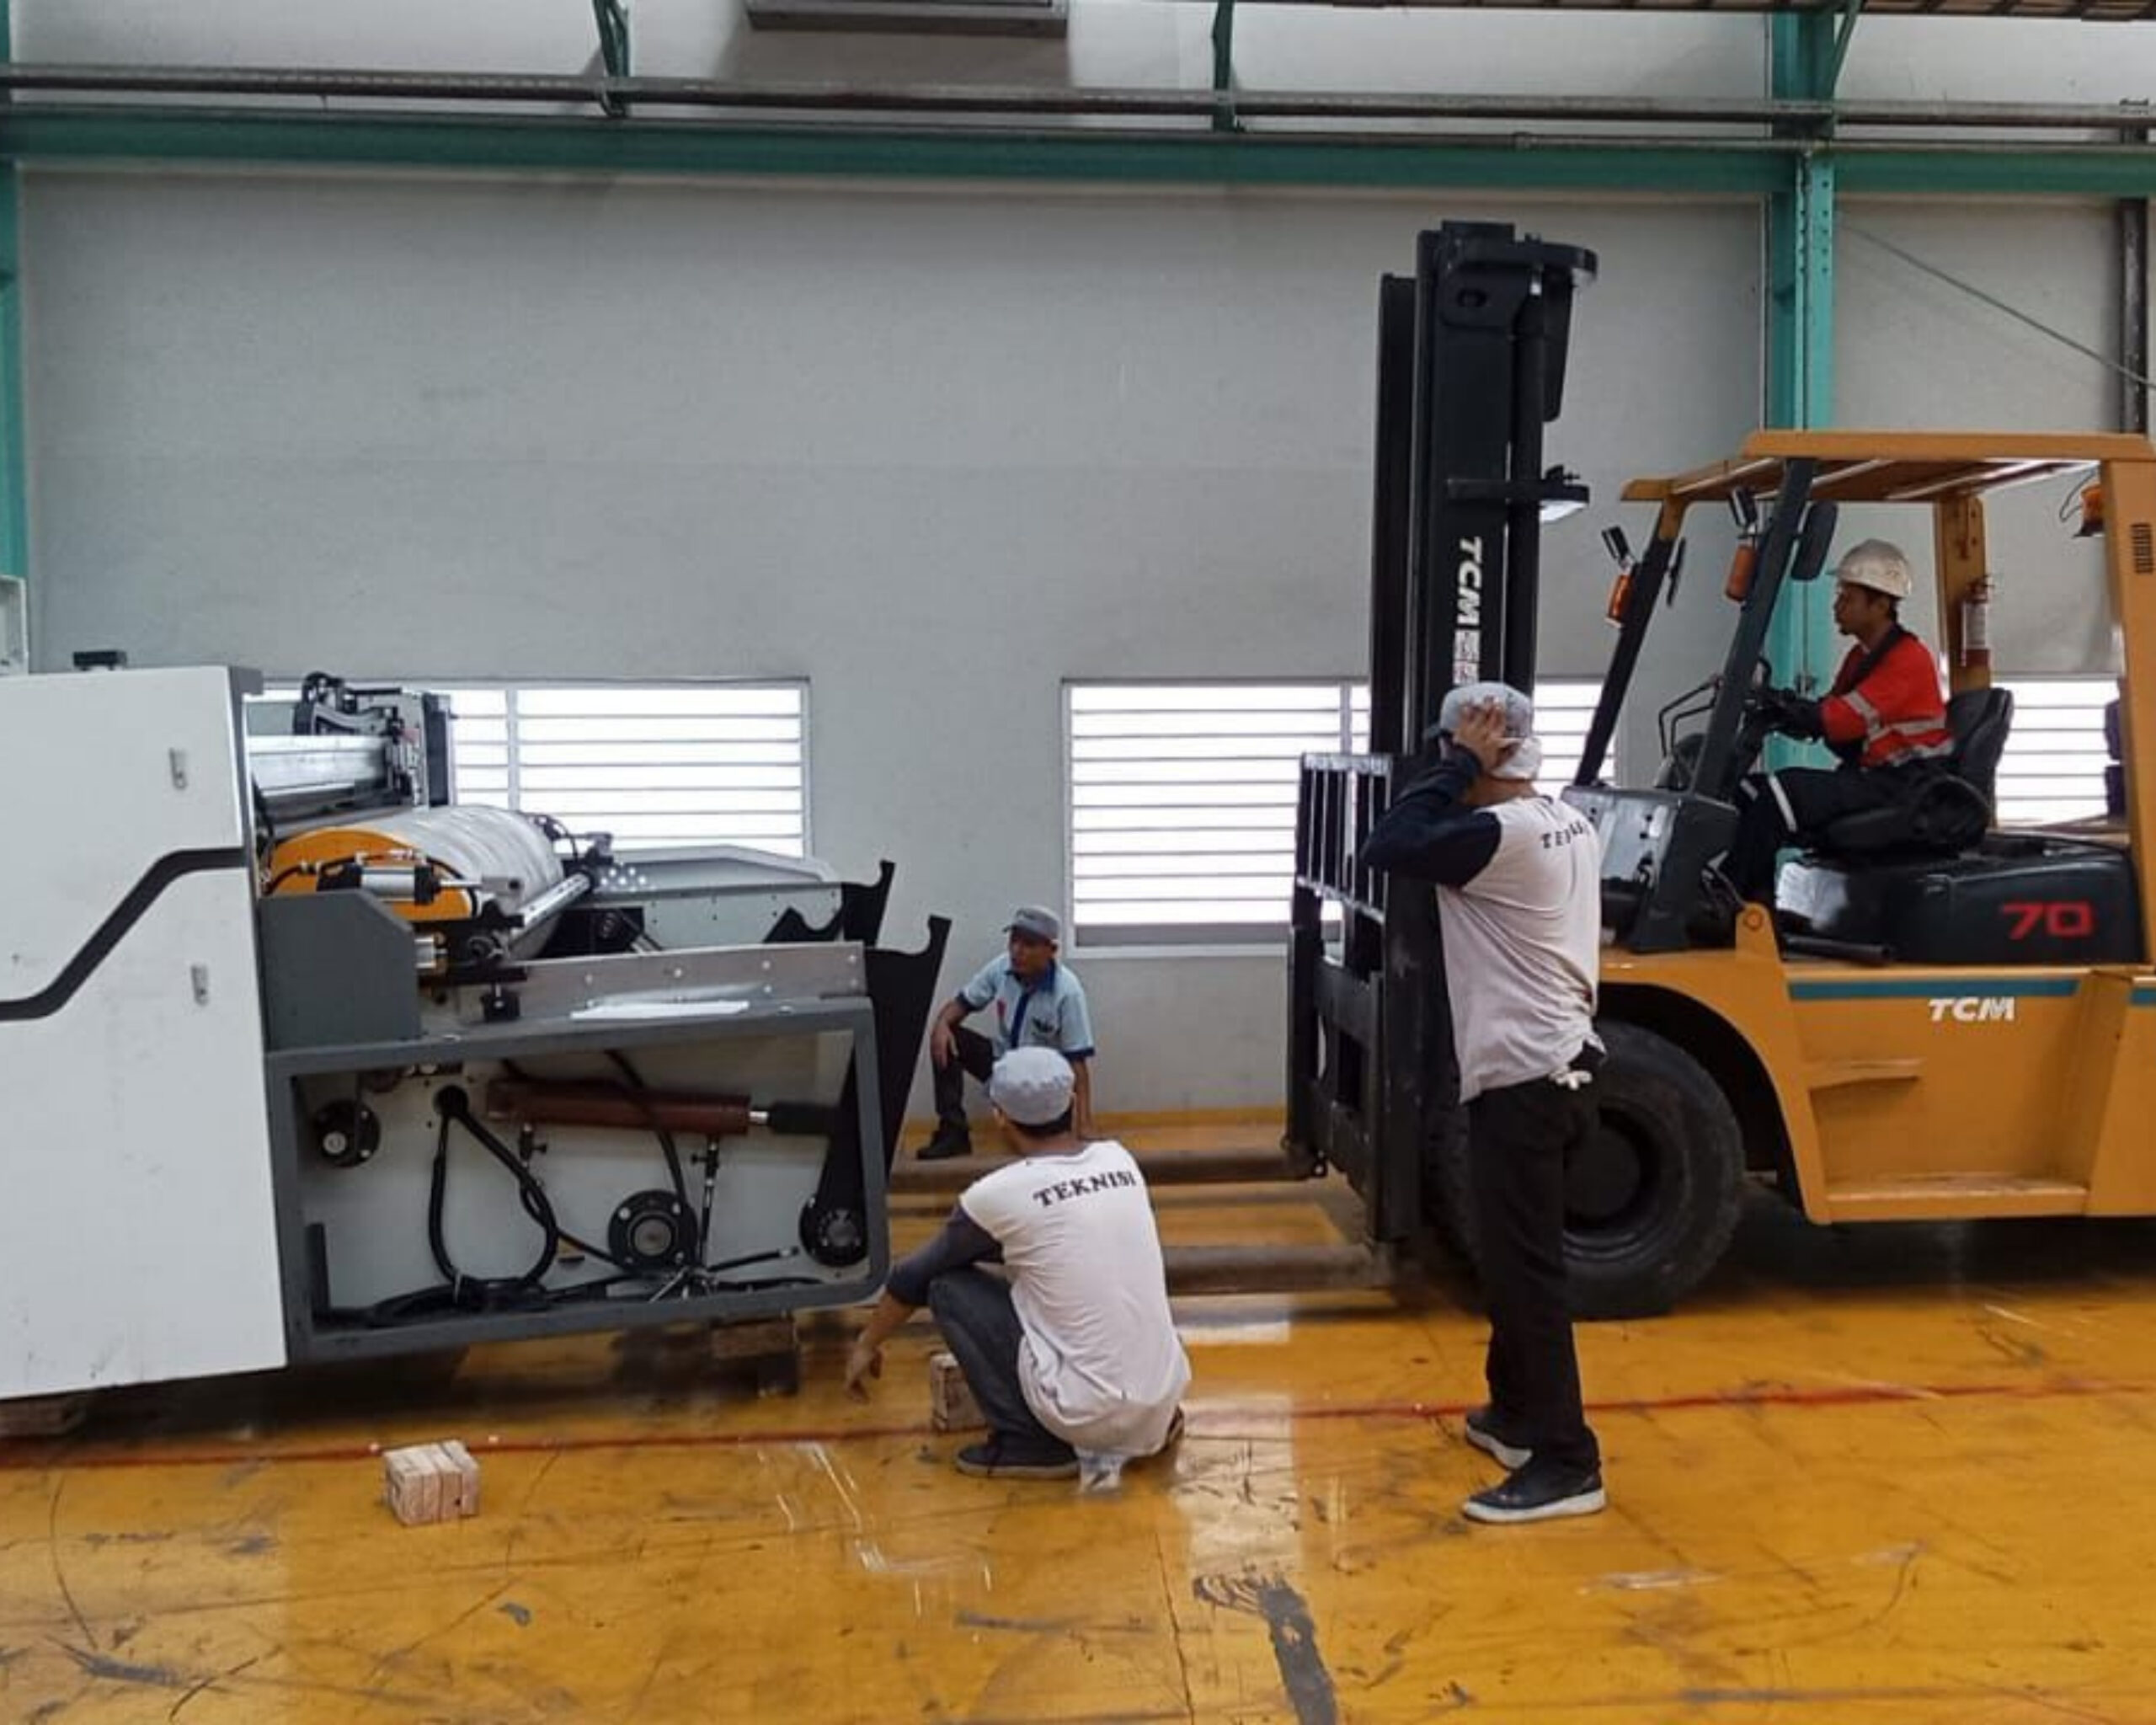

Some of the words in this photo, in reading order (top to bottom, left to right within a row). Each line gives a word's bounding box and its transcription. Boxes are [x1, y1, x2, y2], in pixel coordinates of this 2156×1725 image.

[1456, 536, 1482, 625] TCM
[2002, 900, 2095, 941] 70
[1929, 996, 2015, 1022] TCM
